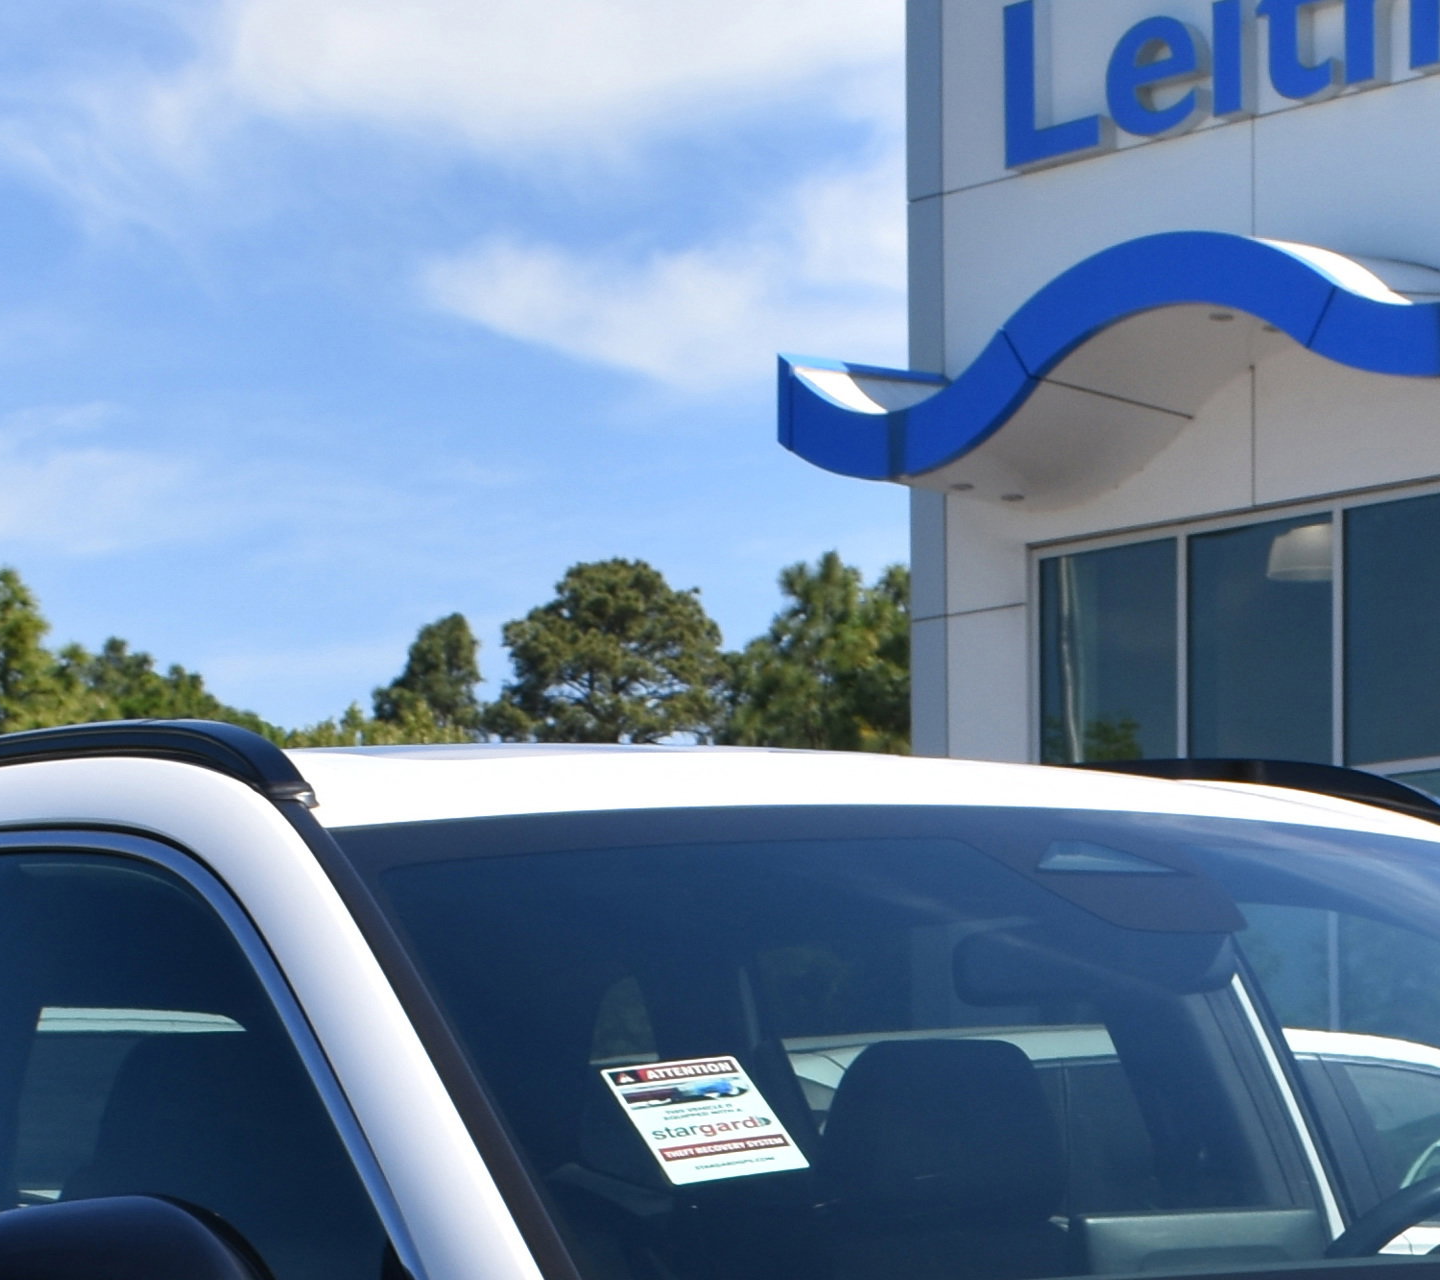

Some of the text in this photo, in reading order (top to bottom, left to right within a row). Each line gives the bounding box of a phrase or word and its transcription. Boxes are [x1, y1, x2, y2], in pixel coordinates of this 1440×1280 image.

[645, 1061, 733, 1081] ATTENTION
[651, 1115, 760, 1140] stargard
[663, 1136, 786, 1159] THEFT RECOVERY SYSTEM
